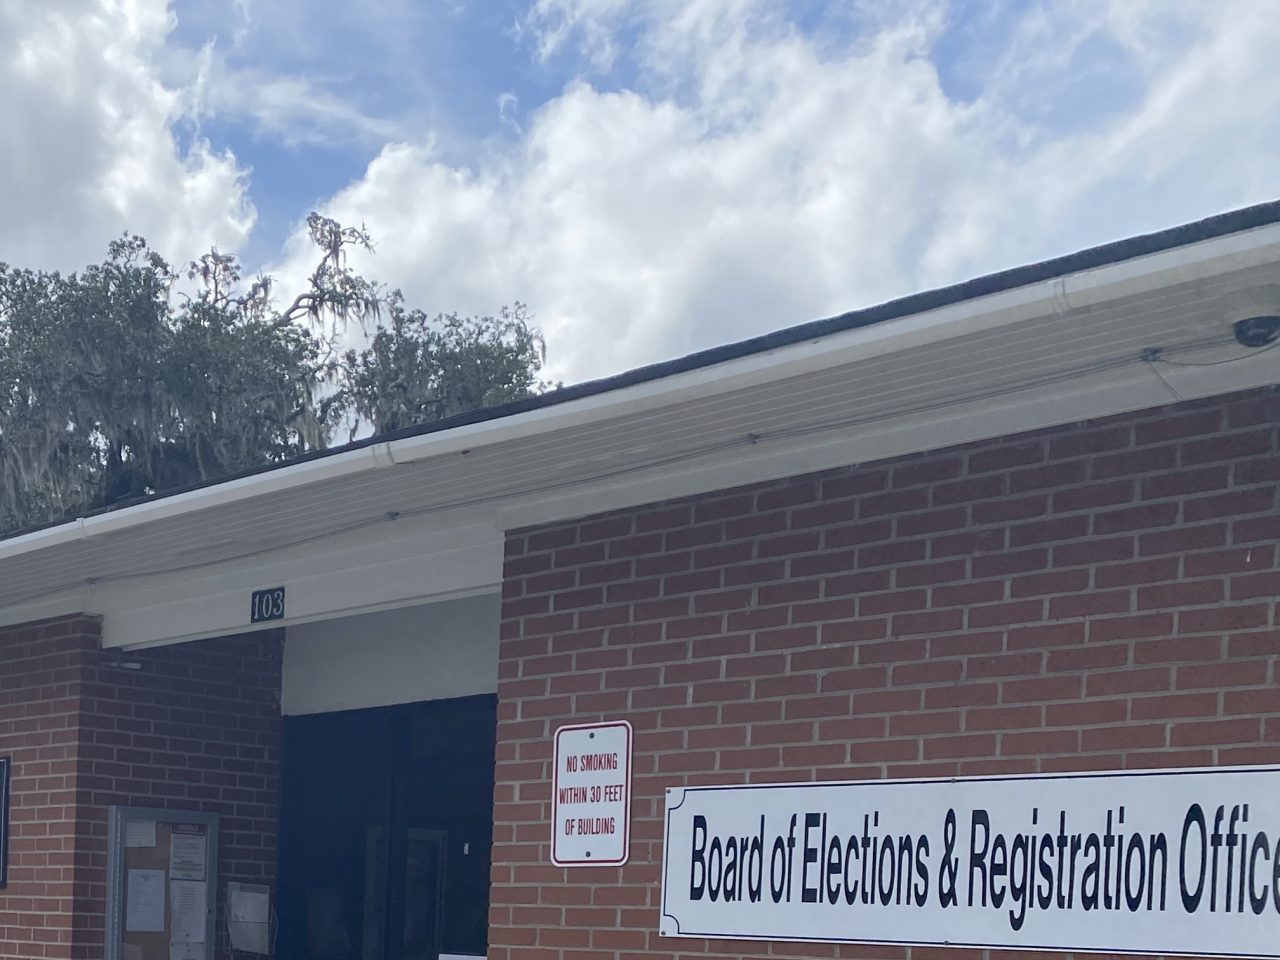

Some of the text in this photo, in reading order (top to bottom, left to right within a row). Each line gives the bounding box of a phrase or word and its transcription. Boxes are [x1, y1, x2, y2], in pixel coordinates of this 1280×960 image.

[253, 590, 283, 619] 103
[566, 752, 618, 773] NO SMOKING
[559, 784, 624, 804] WITHIN 30 FEET
[565, 817, 615, 836] OF BUILDING
[689, 814, 766, 903] Board
[770, 813, 798, 904] of
[800, 811, 930, 907] Elections
[938, 807, 959, 908] &
[967, 806, 1167, 931] Registration
